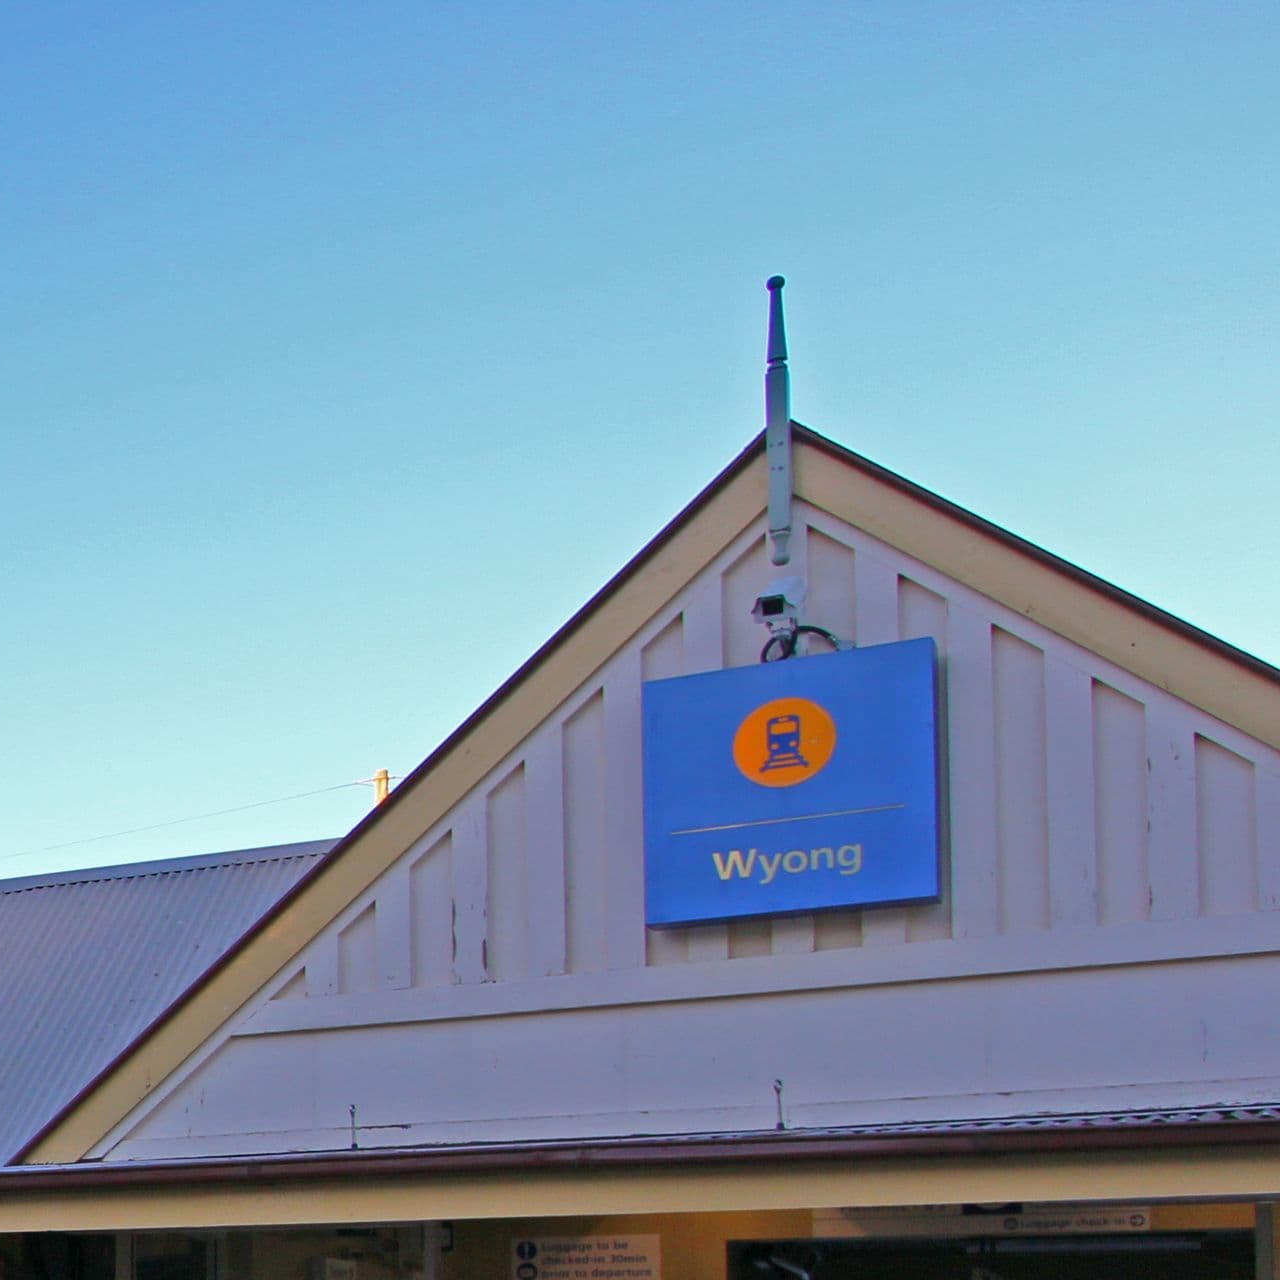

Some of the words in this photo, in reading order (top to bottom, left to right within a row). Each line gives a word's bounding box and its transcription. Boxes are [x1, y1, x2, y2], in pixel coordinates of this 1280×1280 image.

[712, 843, 863, 885] Wyong
[542, 1242, 593, 1253] Luggage
[597, 1241, 609, 1250] to
[614, 1240, 629, 1250] be
[542, 1254, 606, 1265] checked-in
[611, 1254, 648, 1264] 30min
[541, 1269, 570, 1280] prior
[575, 1268, 587, 1278] to
[592, 1268, 652, 1279] departure
